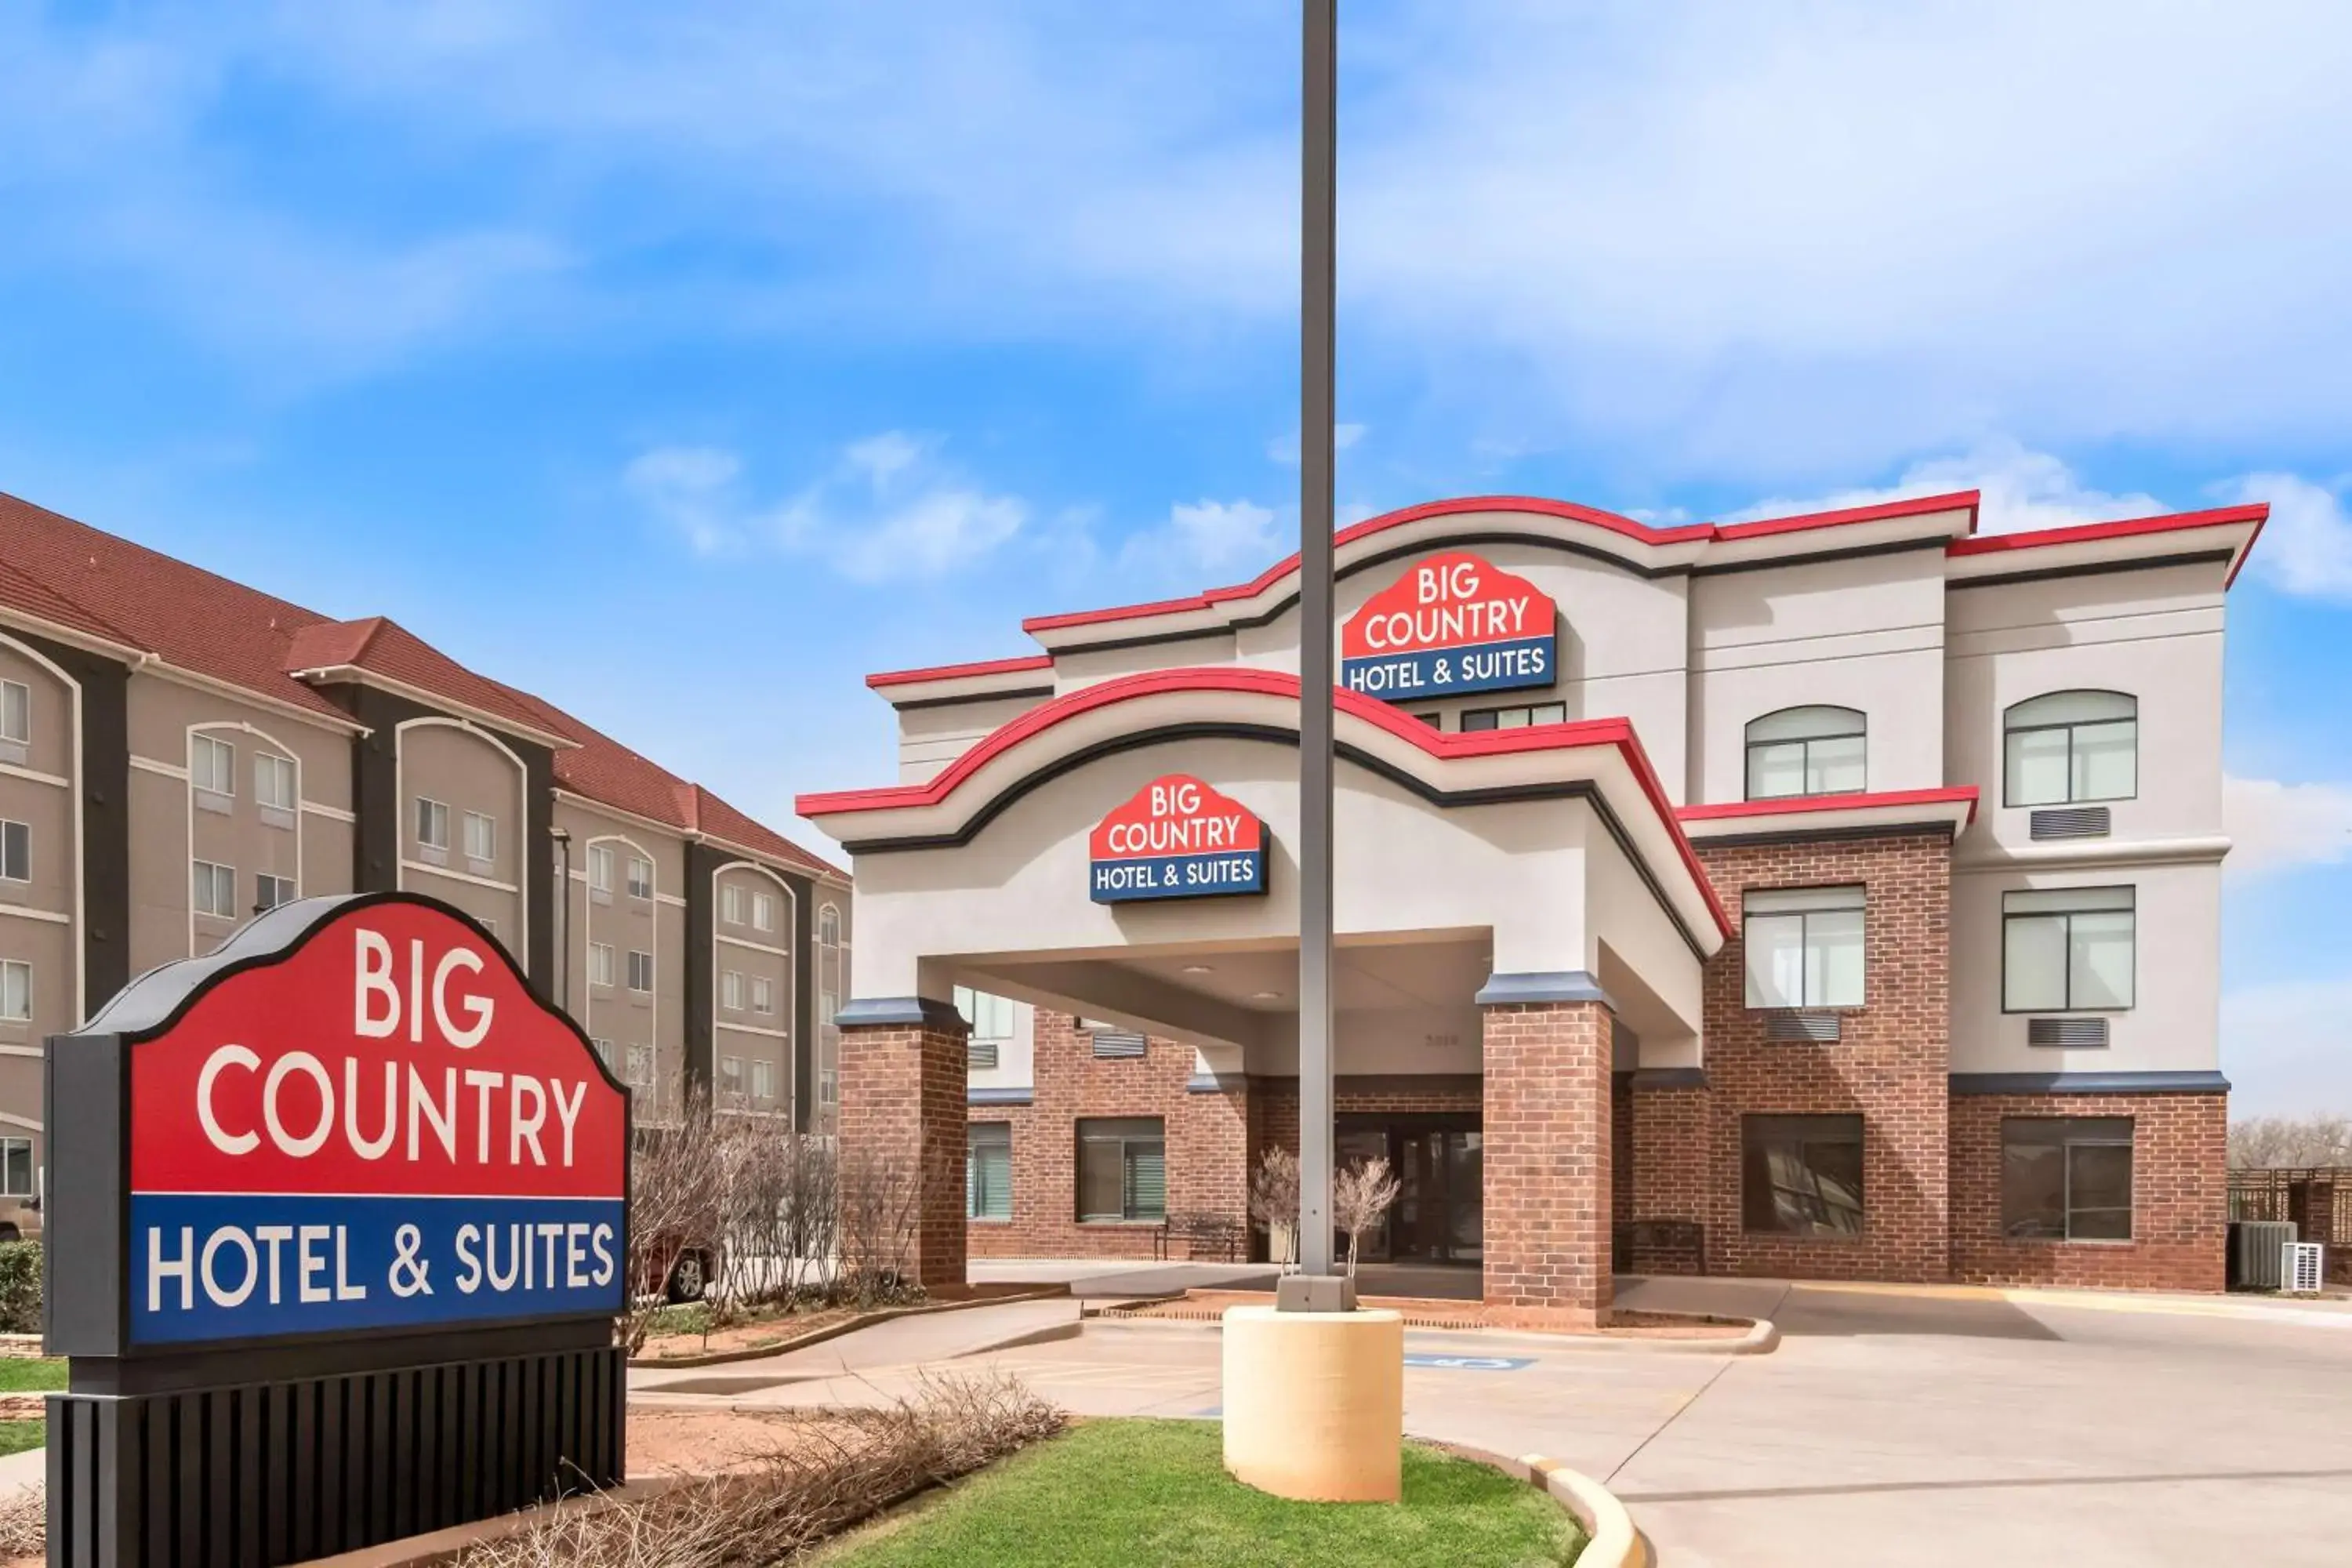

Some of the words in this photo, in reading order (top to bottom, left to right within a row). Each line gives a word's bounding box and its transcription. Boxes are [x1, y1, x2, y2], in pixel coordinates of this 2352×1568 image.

[1418, 562, 1480, 604] BIG
[1365, 596, 1530, 648] COUNTRY
[1349, 661, 1425, 691] HOTEL
[1432, 659, 1453, 684] &
[1461, 647, 1546, 681] SUITES
[1152, 783, 1201, 817] BIG
[1108, 815, 1241, 853] COUNTRY
[1097, 866, 1158, 890] HOTEL
[1163, 864, 1180, 887] &
[1185, 858, 1254, 884] SUITES
[355, 928, 495, 1049] BIG
[196, 1044, 588, 1167] COUNTRY
[147, 1225, 367, 1312] HOTEL
[388, 1223, 434, 1298] &
[455, 1222, 615, 1294] SUITES
